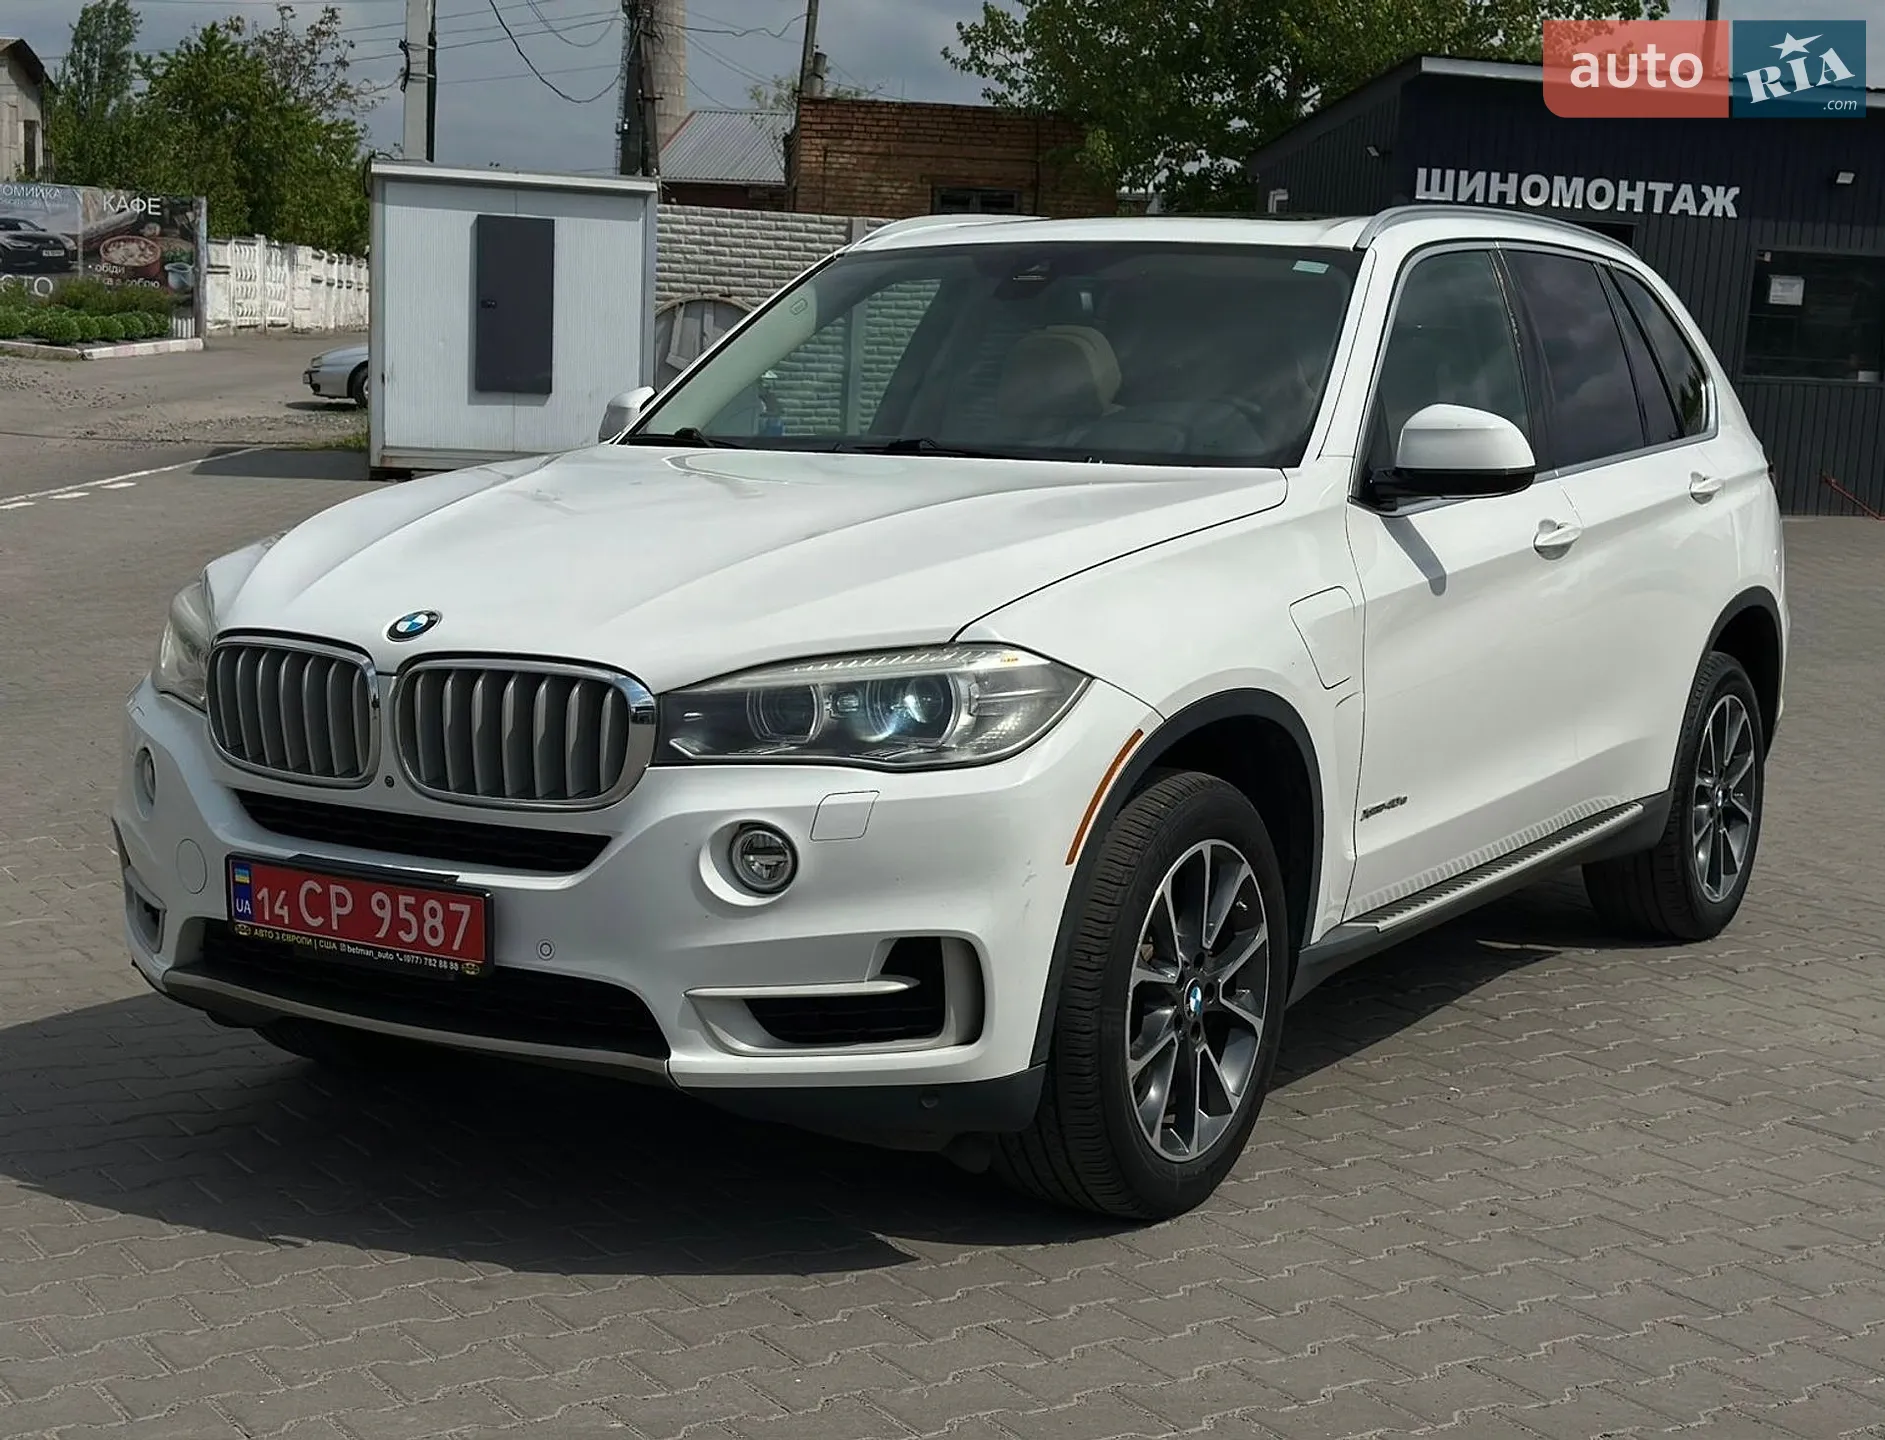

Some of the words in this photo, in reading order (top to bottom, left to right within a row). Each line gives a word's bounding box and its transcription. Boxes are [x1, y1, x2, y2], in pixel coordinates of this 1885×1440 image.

[1415, 167, 1741, 219] ШИНОМОНТАЖ
[103, 194, 162, 216] КАФЕ
[94, 262, 126, 275] обіди
[235, 900, 252, 915] UA
[256, 887, 290, 925] 14
[299, 879, 353, 931] CP
[370, 891, 472, 951] 9587
